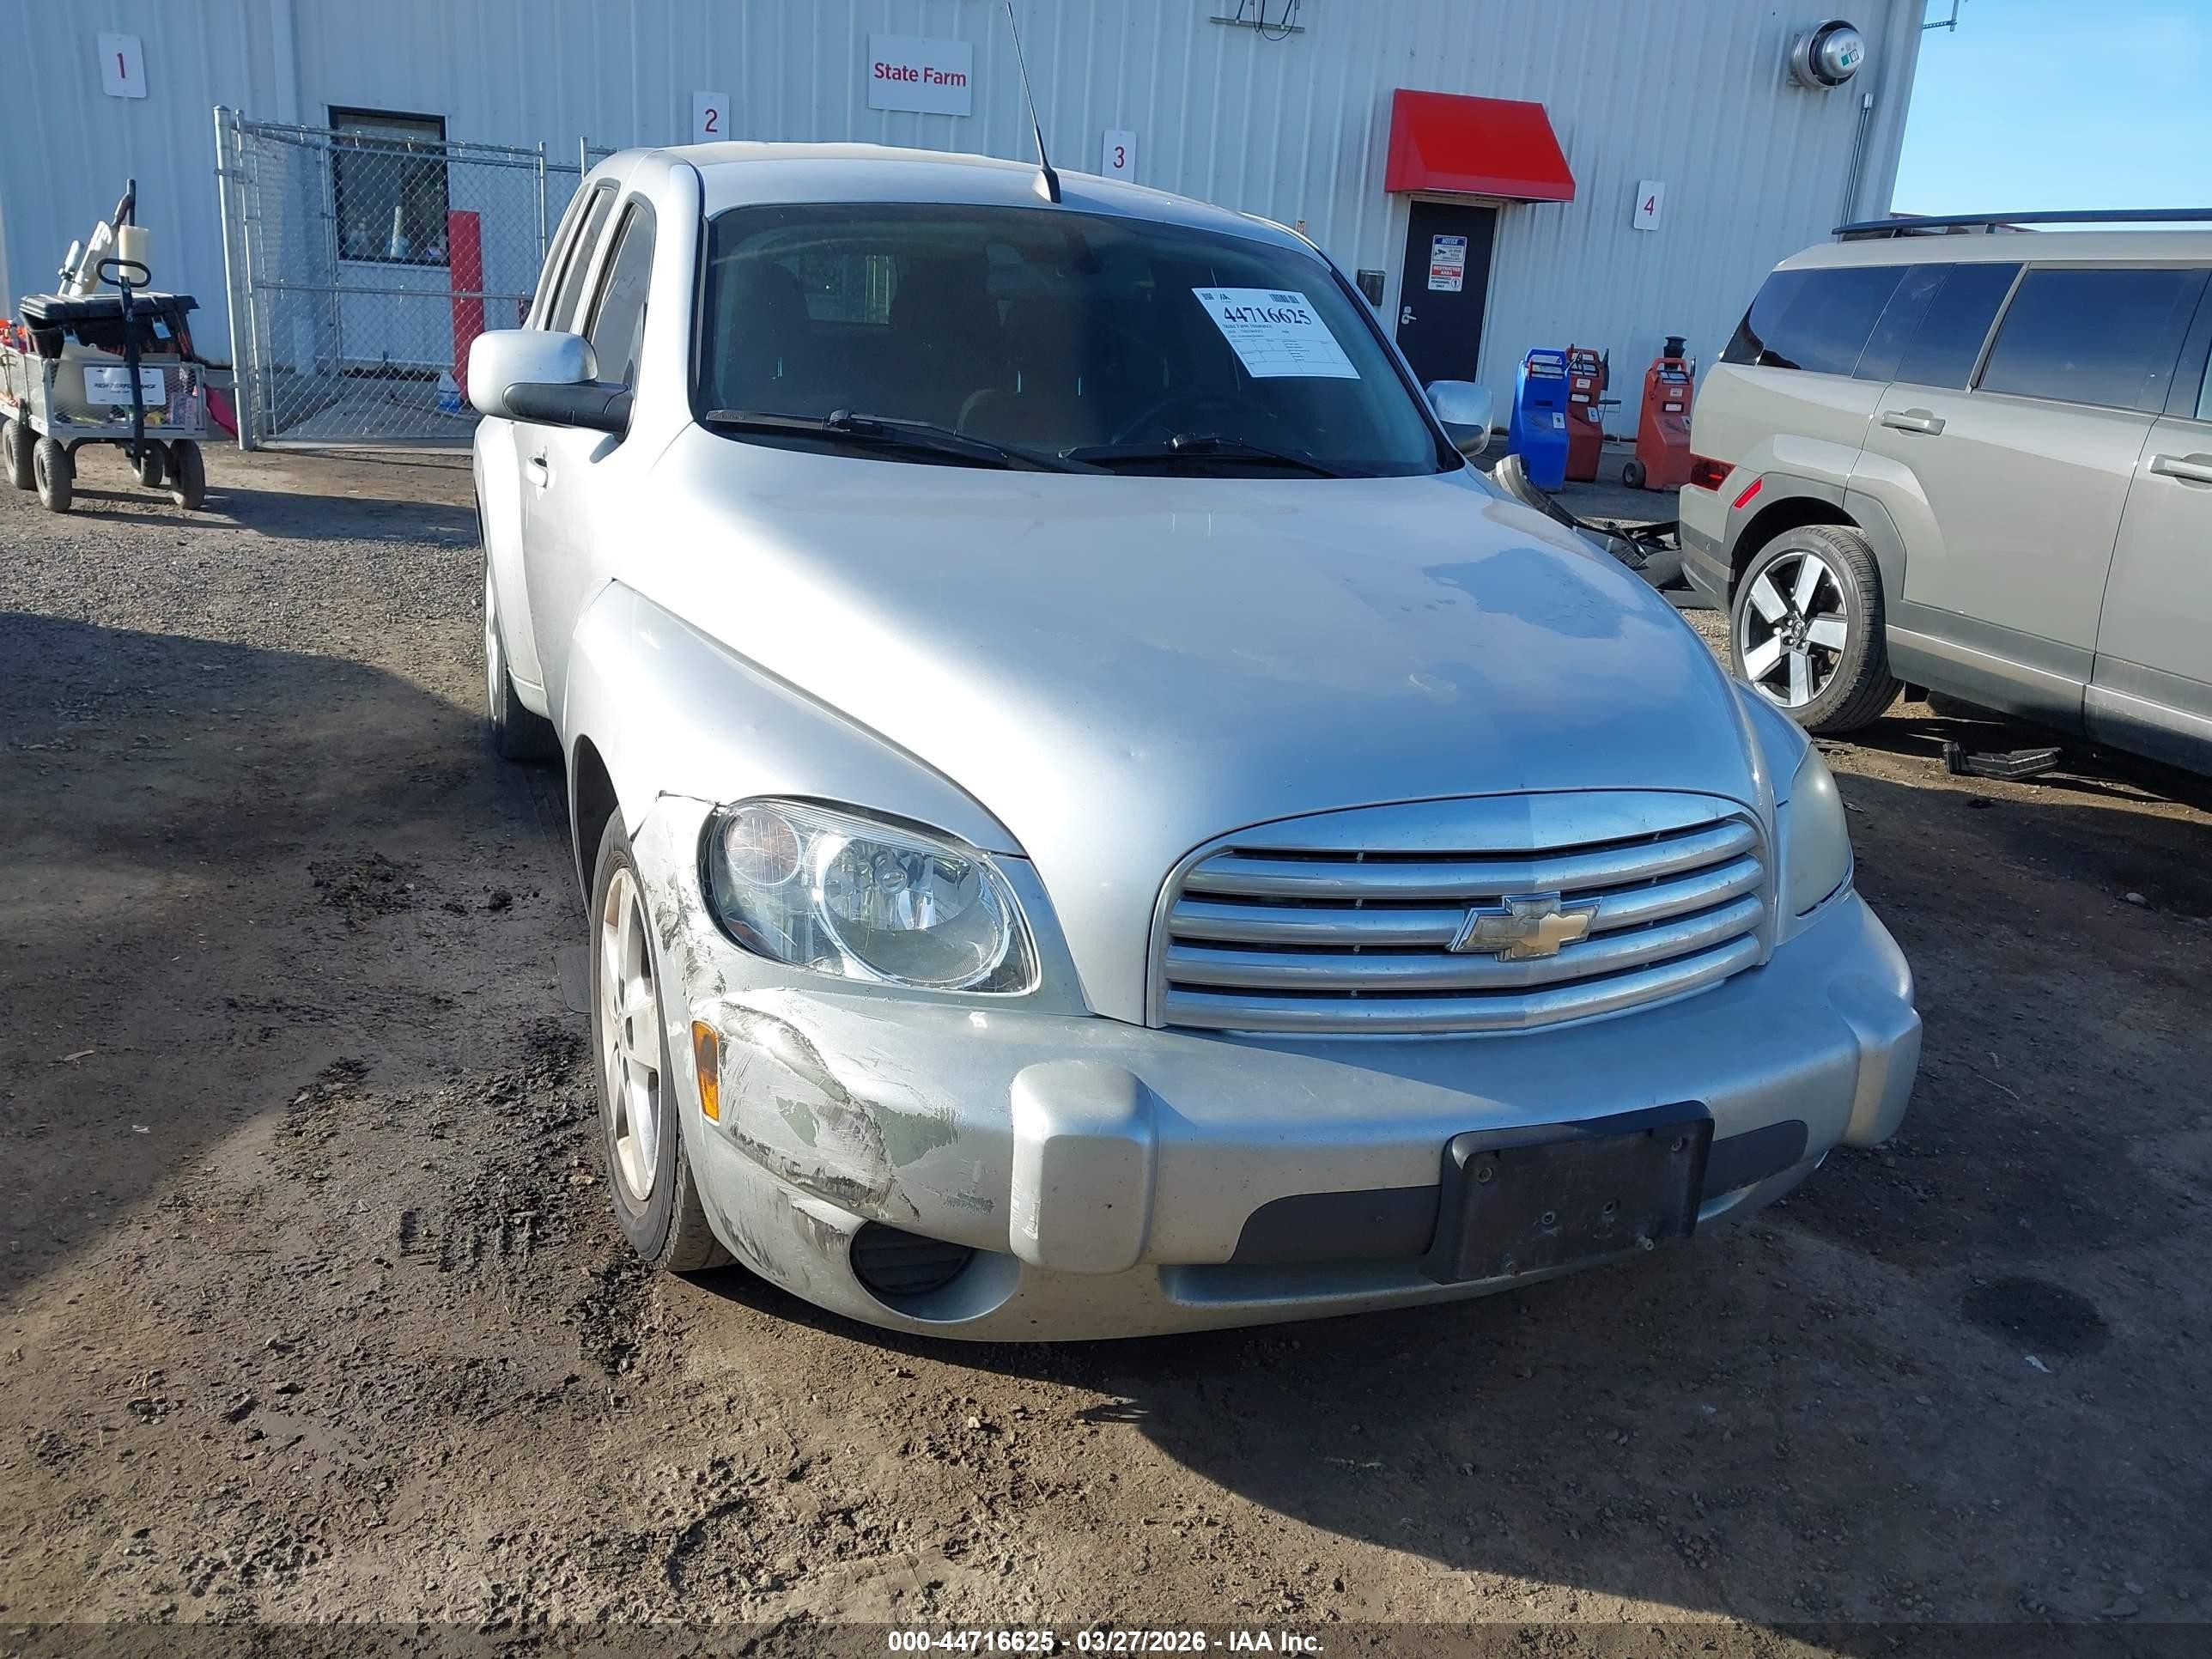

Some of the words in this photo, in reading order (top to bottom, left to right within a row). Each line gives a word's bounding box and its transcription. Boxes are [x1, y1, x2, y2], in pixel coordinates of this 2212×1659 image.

[116, 52, 126, 79] 1
[874, 62, 919, 82] State
[923, 67, 967, 88] Farm
[705, 108, 718, 133] 2
[1113, 146, 1125, 169] 3
[1644, 195, 1656, 216] 4
[1224, 307, 1312, 325] 44716625
